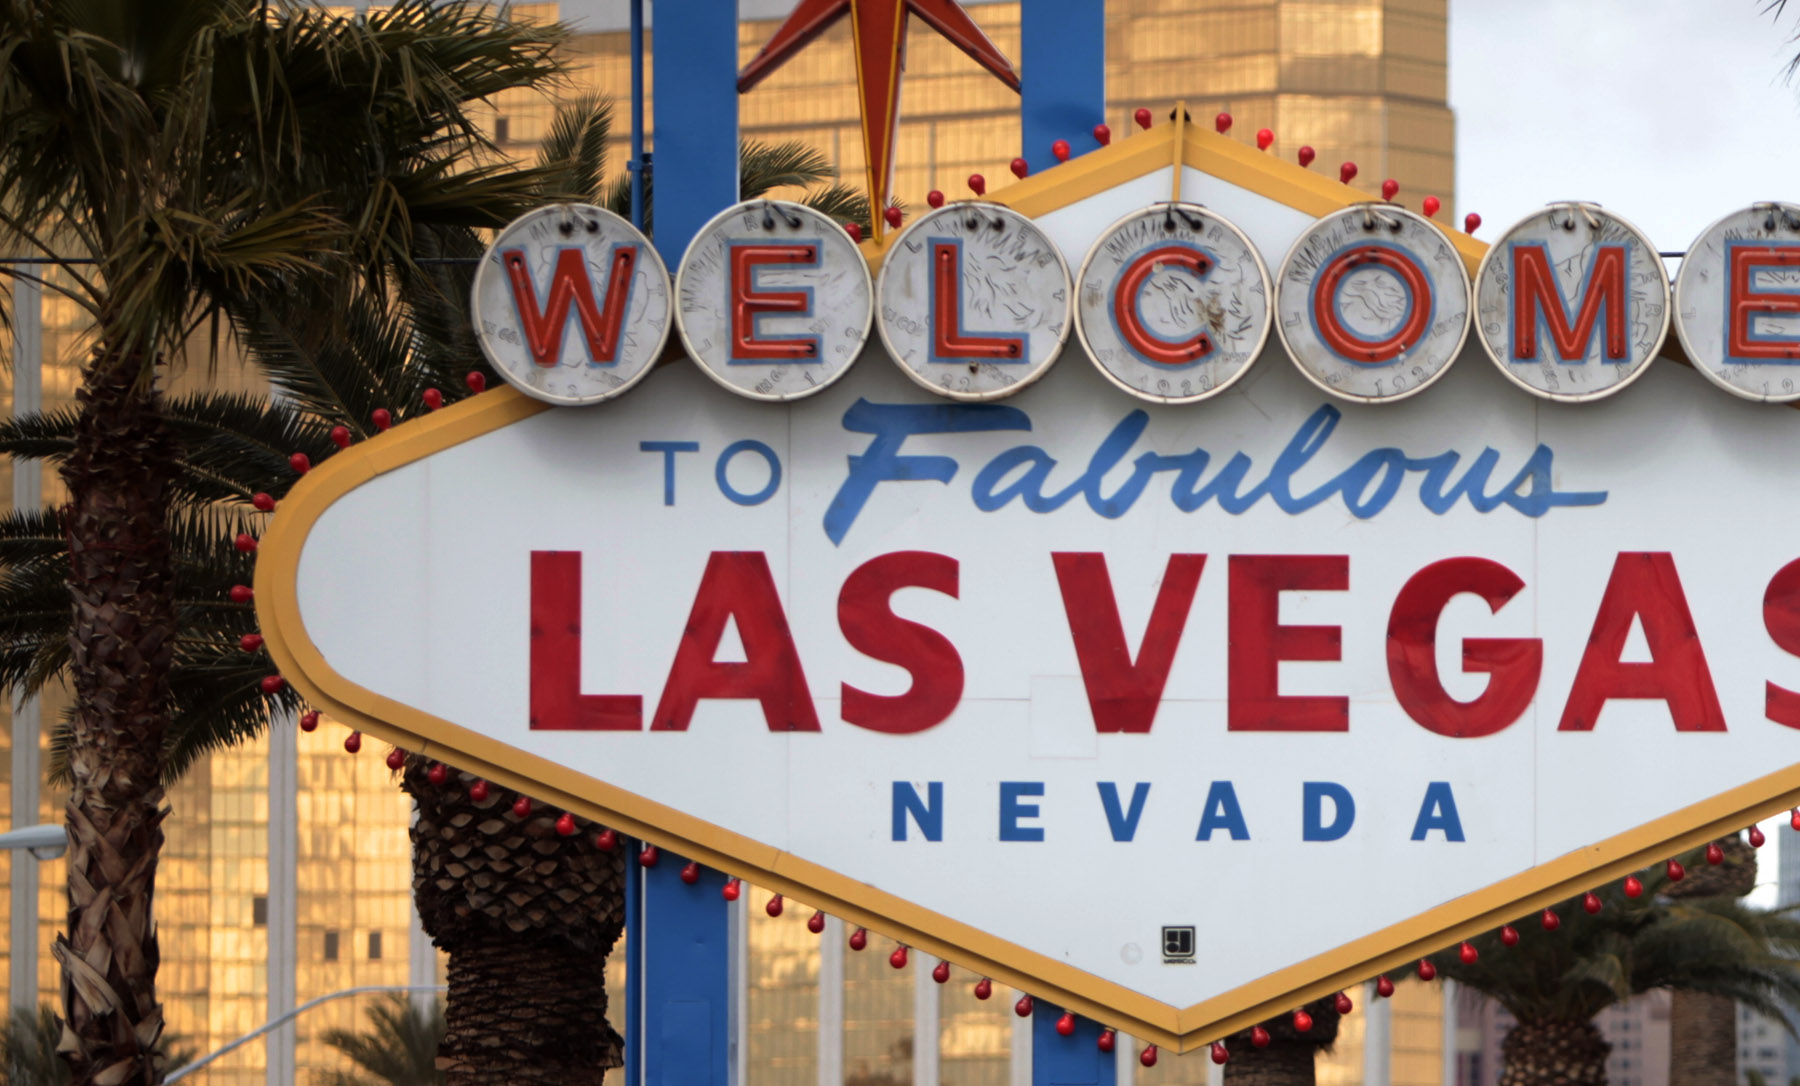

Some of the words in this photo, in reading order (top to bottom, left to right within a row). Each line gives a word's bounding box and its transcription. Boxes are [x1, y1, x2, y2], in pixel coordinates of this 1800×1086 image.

[640, 440, 781, 507] TO
[823, 397, 1608, 546] Fabulous
[528, 550, 966, 736] LAS
[890, 780, 1467, 843] NEVADA
